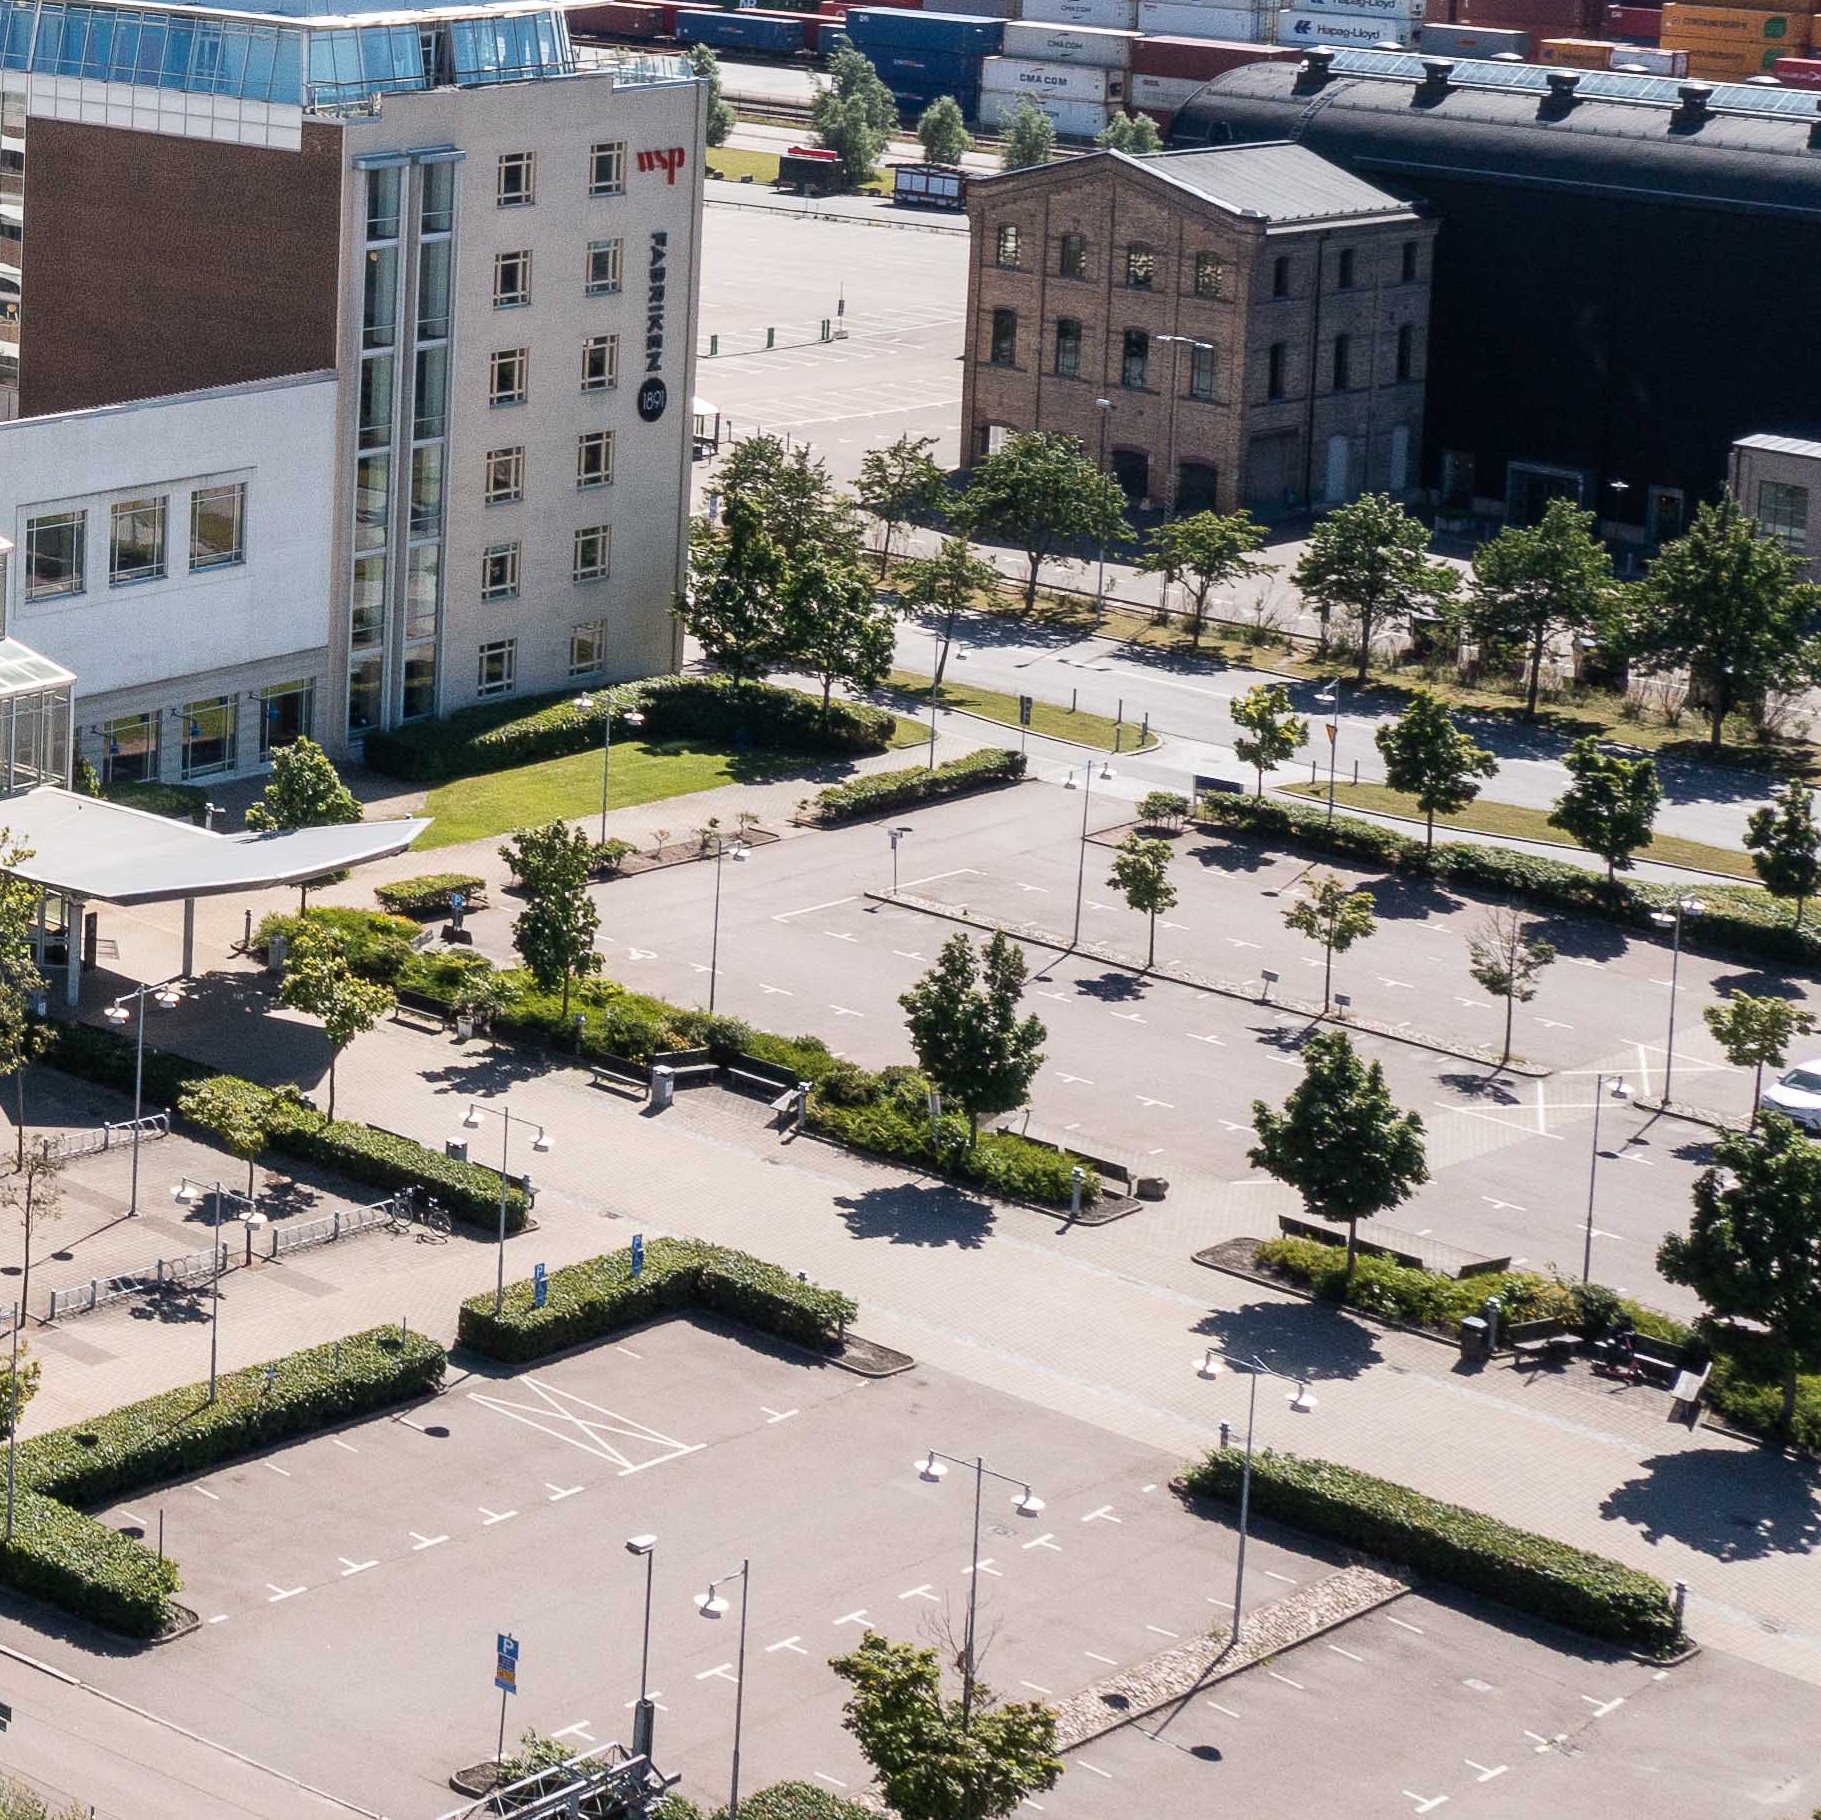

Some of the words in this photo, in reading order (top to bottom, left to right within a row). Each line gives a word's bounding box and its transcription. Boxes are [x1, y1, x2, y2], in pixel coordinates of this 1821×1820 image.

[1317, 24, 1380, 40] Hapag-Lloyd
[1019, 74, 1042, 83] CMA
[646, 232, 667, 373] FABRIKEN
[643, 389, 665, 411] 1891
